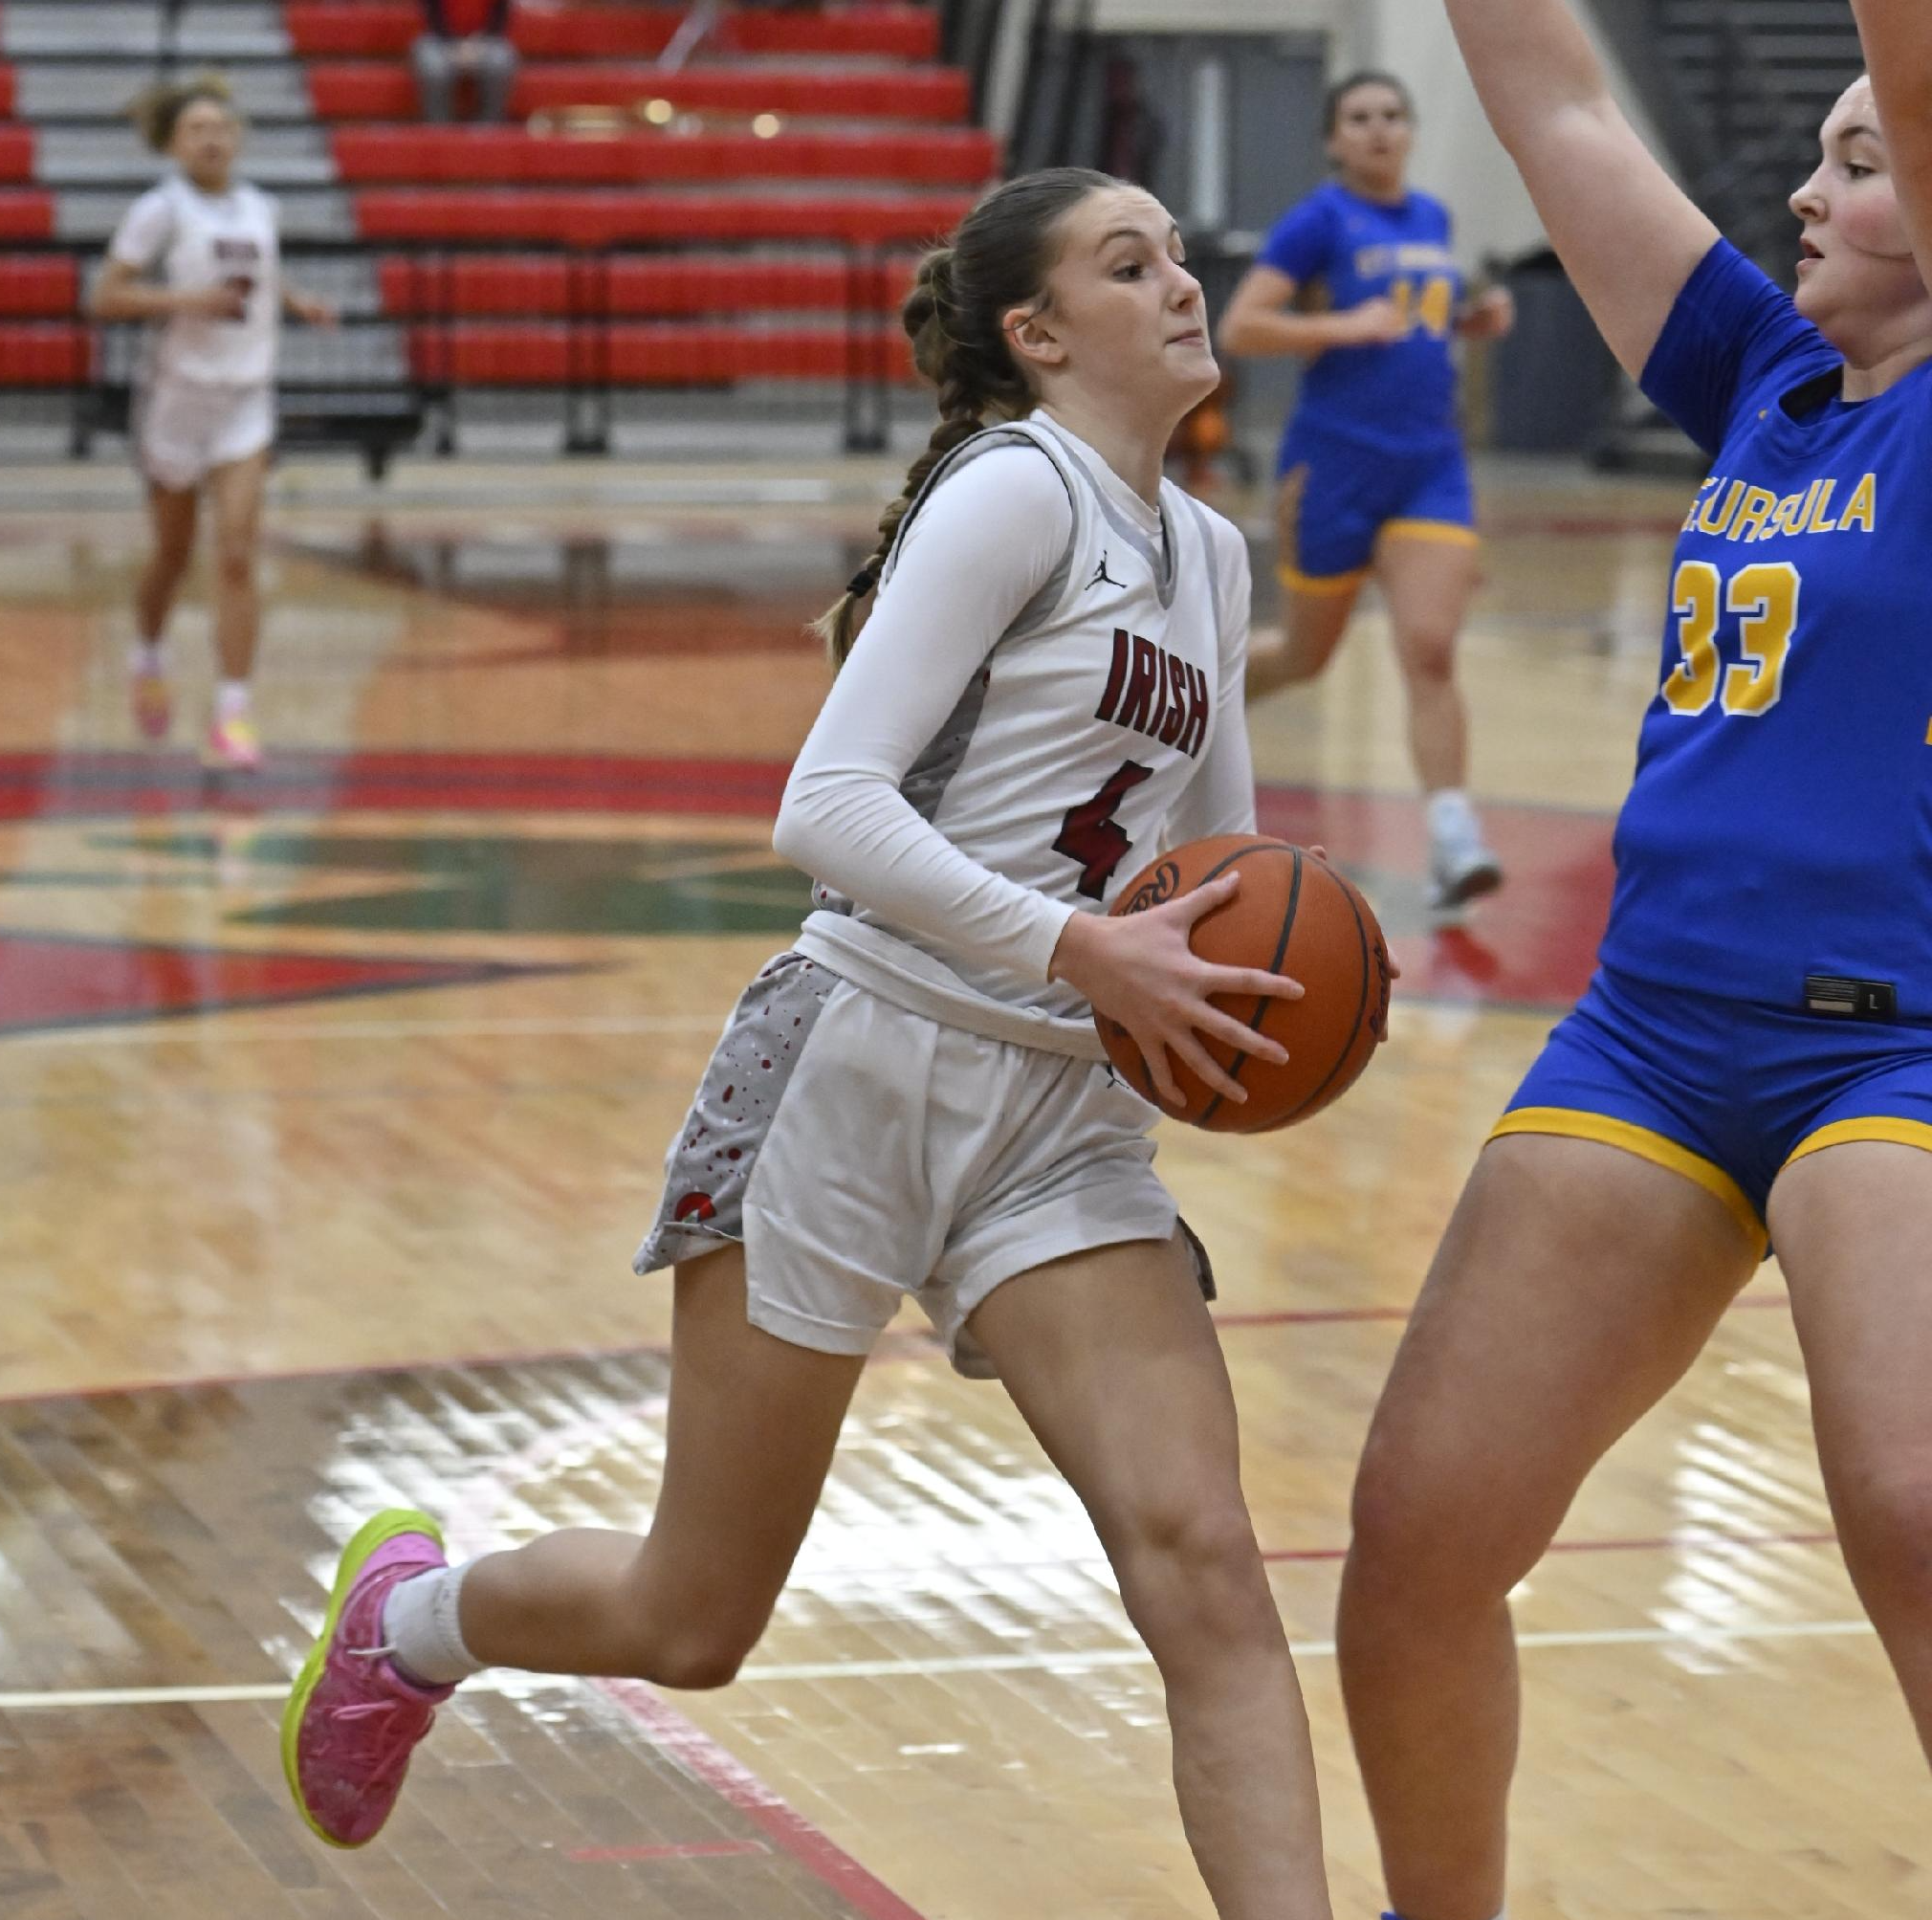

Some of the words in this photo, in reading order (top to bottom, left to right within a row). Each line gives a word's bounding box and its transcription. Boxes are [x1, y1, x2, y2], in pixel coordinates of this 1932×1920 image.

[1094, 628, 1209, 760] IRISH
[1661, 561, 1802, 717] 33
[1052, 760, 1154, 902] 4
[1869, 993, 1878, 1010] L
